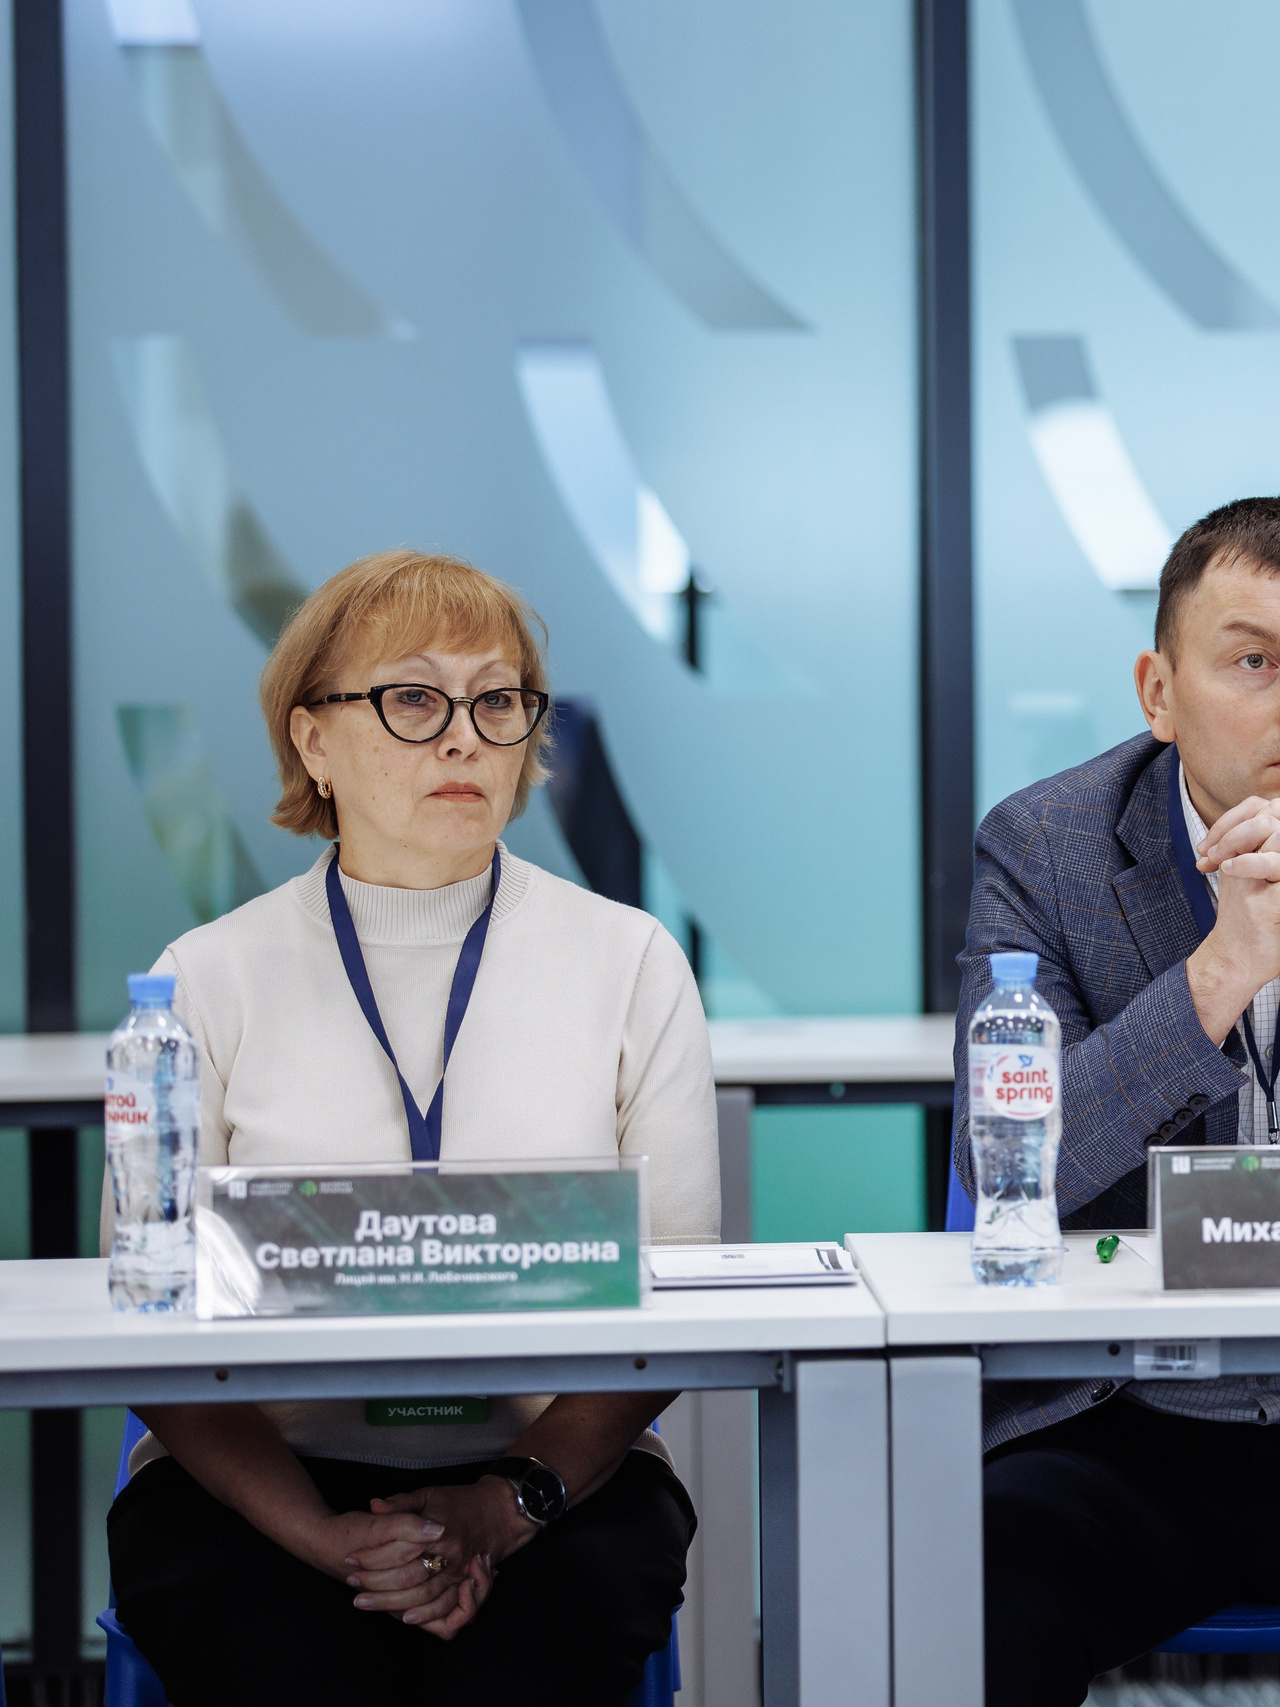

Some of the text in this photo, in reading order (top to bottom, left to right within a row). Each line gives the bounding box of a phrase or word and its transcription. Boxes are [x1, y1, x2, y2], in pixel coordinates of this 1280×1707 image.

[1002, 1067, 1049, 1084] saint
[996, 1086, 1053, 1105] spring
[354, 1209, 497, 1242] Даутова
[255, 1239, 620, 1270] Светлана Викторовна
[387, 1405, 464, 1417] УЧАСТНИК
